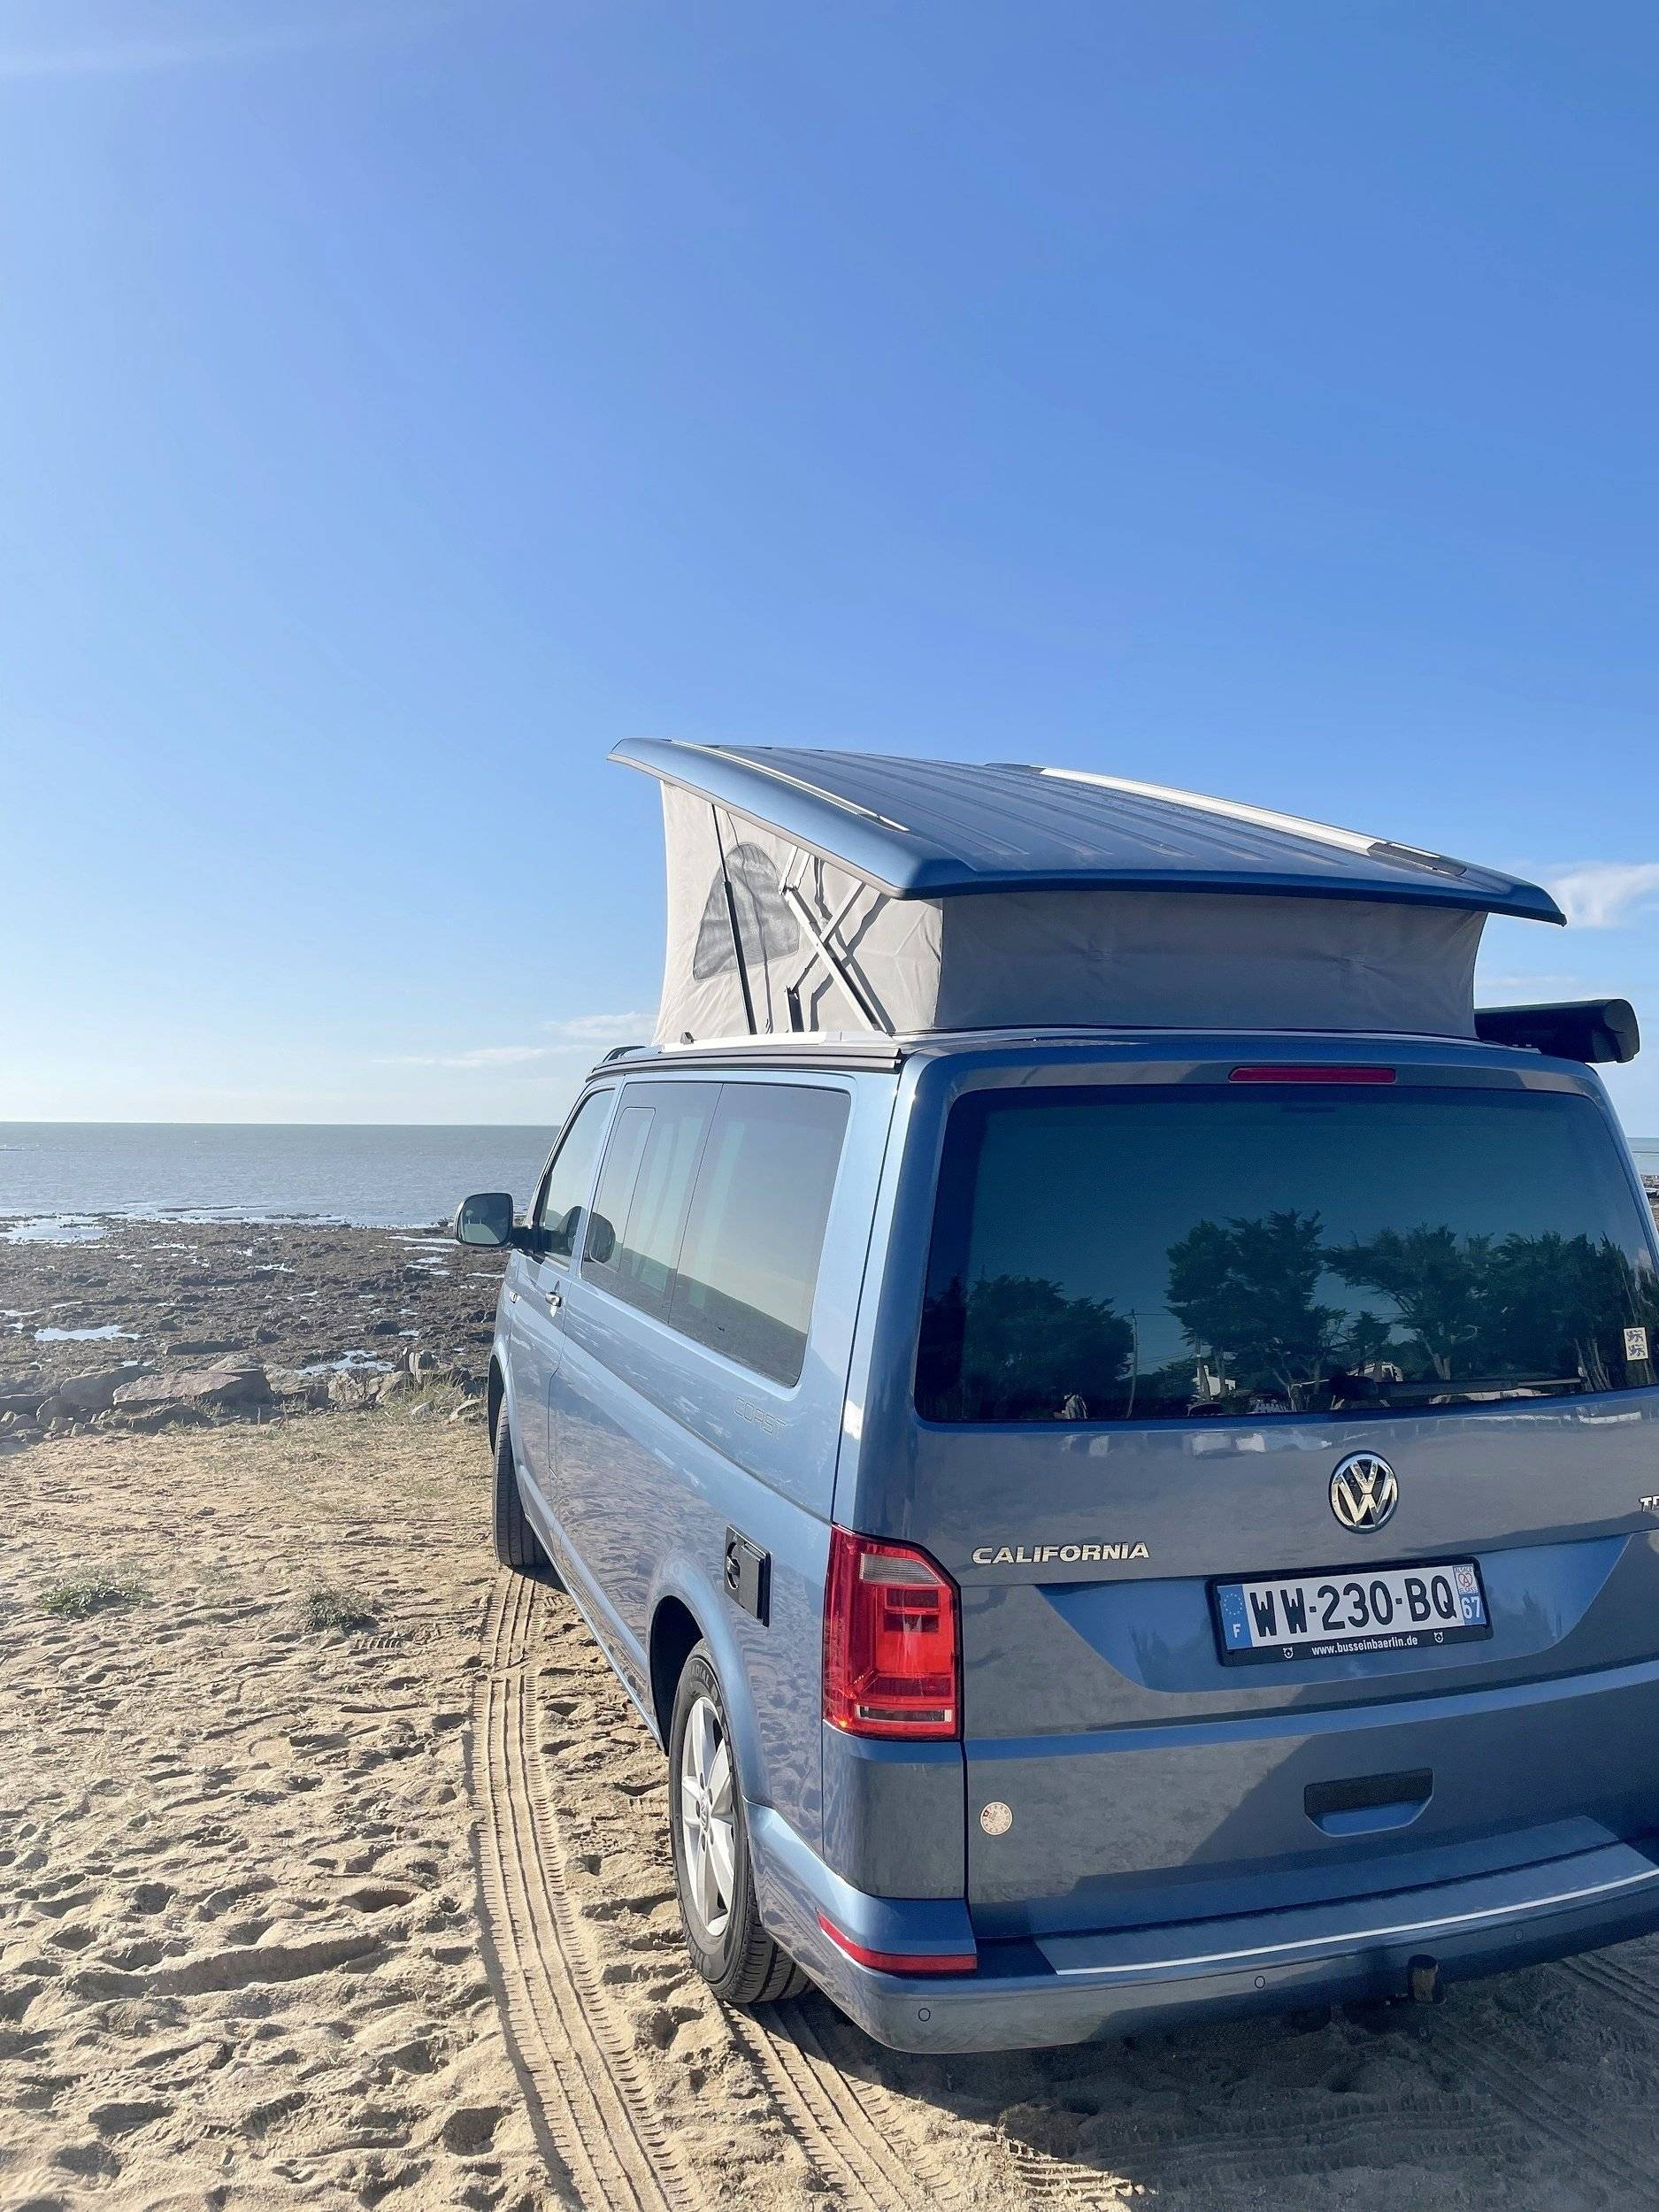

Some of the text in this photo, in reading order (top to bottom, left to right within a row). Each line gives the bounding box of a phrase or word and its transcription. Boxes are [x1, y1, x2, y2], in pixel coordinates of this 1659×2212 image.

[733, 1395, 787, 1439] COAST
[972, 1542, 1150, 1564] CALIFORNIA
[1233, 1574, 1480, 1639] F WW-230-BQ 67
[1311, 1635, 1418, 1656] www.busseinbaerlin.de
